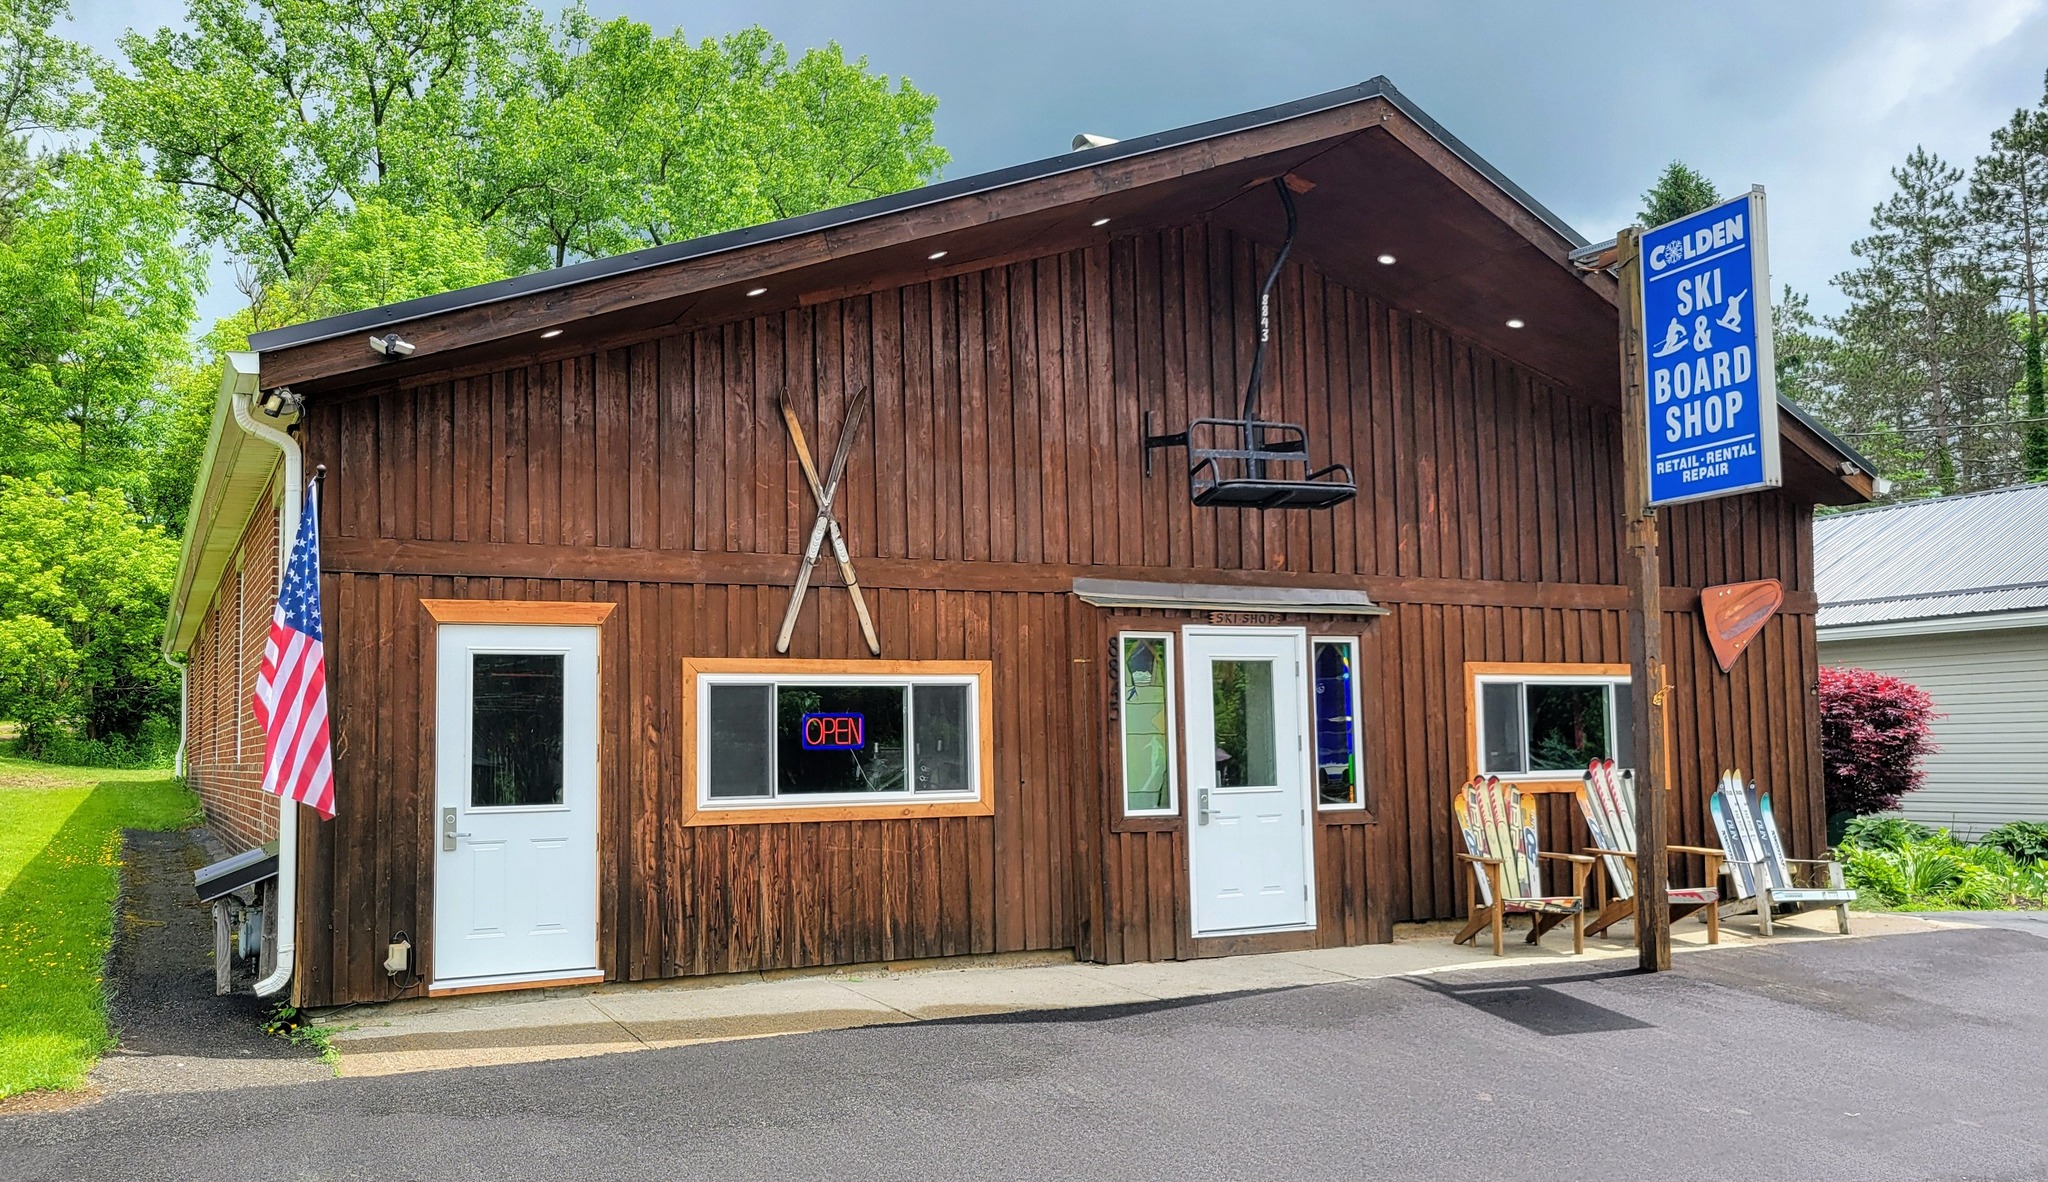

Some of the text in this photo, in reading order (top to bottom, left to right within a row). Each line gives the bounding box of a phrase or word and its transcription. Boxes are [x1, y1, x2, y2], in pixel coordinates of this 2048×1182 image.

[1677, 267, 1722, 317] SKI
[1260, 294, 1270, 342] 8843
[1693, 314, 1714, 352] &
[1654, 345, 1752, 405] BOARD
[1665, 390, 1744, 443] SHOP
[1656, 442, 1756, 475] RETAIL RENTAL
[1682, 462, 1729, 483] REPAIR
[1216, 613, 1275, 625] SKI SHOP
[805, 717, 862, 745] OPEN
